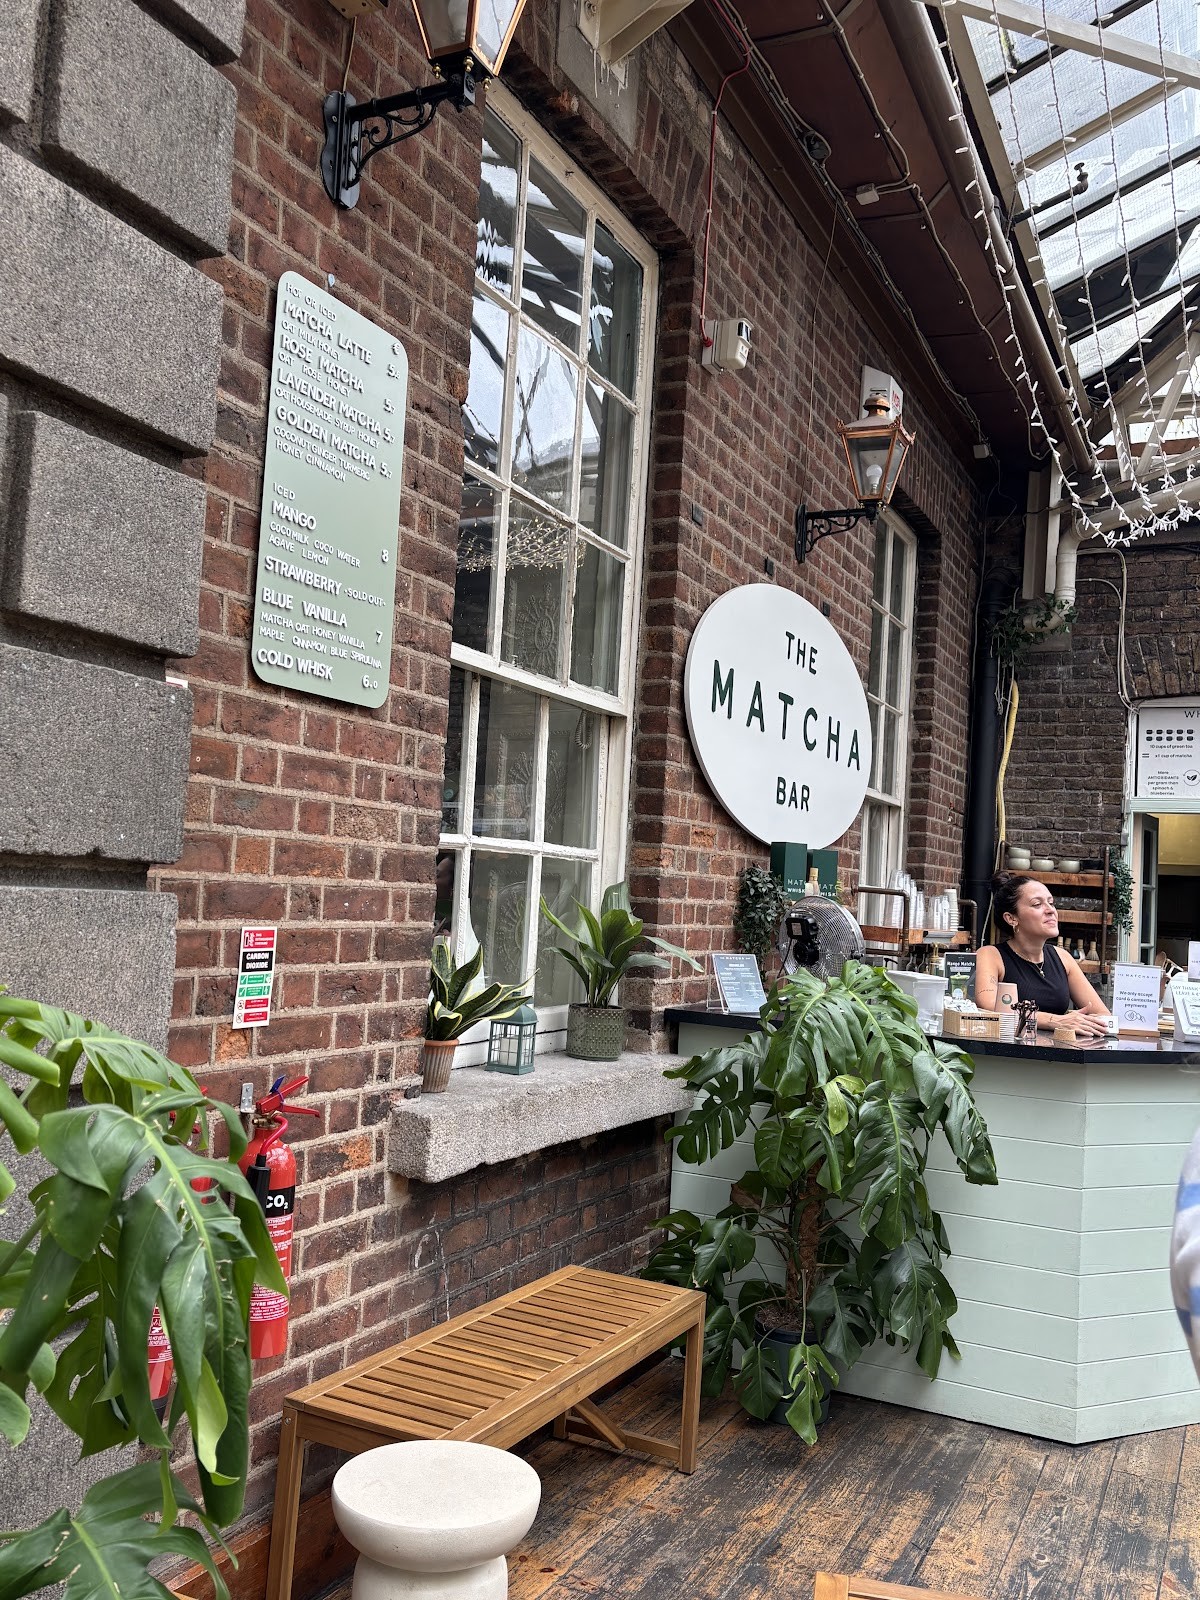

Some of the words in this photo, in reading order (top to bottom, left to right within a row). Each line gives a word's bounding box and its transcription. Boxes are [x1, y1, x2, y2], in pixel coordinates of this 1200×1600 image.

[305, 295, 316, 309] OR
[320, 304, 336, 322] ICED
[282, 320, 297, 334] OAT
[298, 328, 318, 346] MILK
[316, 340, 341, 361] HONEY
[284, 300, 334, 341] MATCHA
[337, 333, 373, 365] LATTE
[278, 352, 294, 366] OAT
[302, 364, 322, 382] ROSE
[326, 376, 350, 398] HONEY
[281, 334, 312, 364] ROSE
[319, 356, 364, 394] MATCHA
[275, 386, 290, 400] OAT
[290, 392, 333, 423] HOUSEMADE
[334, 417, 356, 435] SYRUP
[357, 430, 381, 450] HONEY
[278, 368, 336, 410] LAVENDER
[338, 400, 382, 436] MATCHA
[274, 425, 311, 452] COCONUT
[311, 444, 337, 464] GINGER
[339, 458, 372, 482] TURMERIC
[276, 405, 328, 444] GOLDEN
[330, 432, 377, 470] MATCHA
[276, 440, 304, 460] HONEY
[305, 454, 347, 483] CINNAMON
[273, 482, 296, 500] ICED
[268, 534, 296, 554] AGAVE
[301, 548, 330, 566] LEMON
[272, 500, 317, 531] MANGO
[381, 549, 389, 563] 8
[264, 554, 343, 596] STRAWBERRY
[314, 540, 334, 554] COCO
[336, 549, 361, 568] WATER
[260, 612, 294, 630] MATCHA
[295, 622, 310, 634] OAT
[312, 626, 336, 641] HONEY
[338, 632, 366, 650] VANILLA
[262, 587, 294, 610] BLUE
[302, 600, 348, 628] VANILLA
[375, 630, 383, 644] 7
[257, 648, 294, 670] COLD
[296, 657, 334, 682] WHISK
[259, 626, 286, 642] MAPLE
[330, 646, 348, 659] BLUE
[350, 650, 382, 670] SPIRULINA
[785, 630, 818, 675] THE
[711, 659, 861, 771] MATCHA
[776, 776, 811, 812] BAR
[787, 878, 807, 886] MAT
[246, 952, 270, 960] CARBON
[246, 961, 268, 970] DIOXIDE
